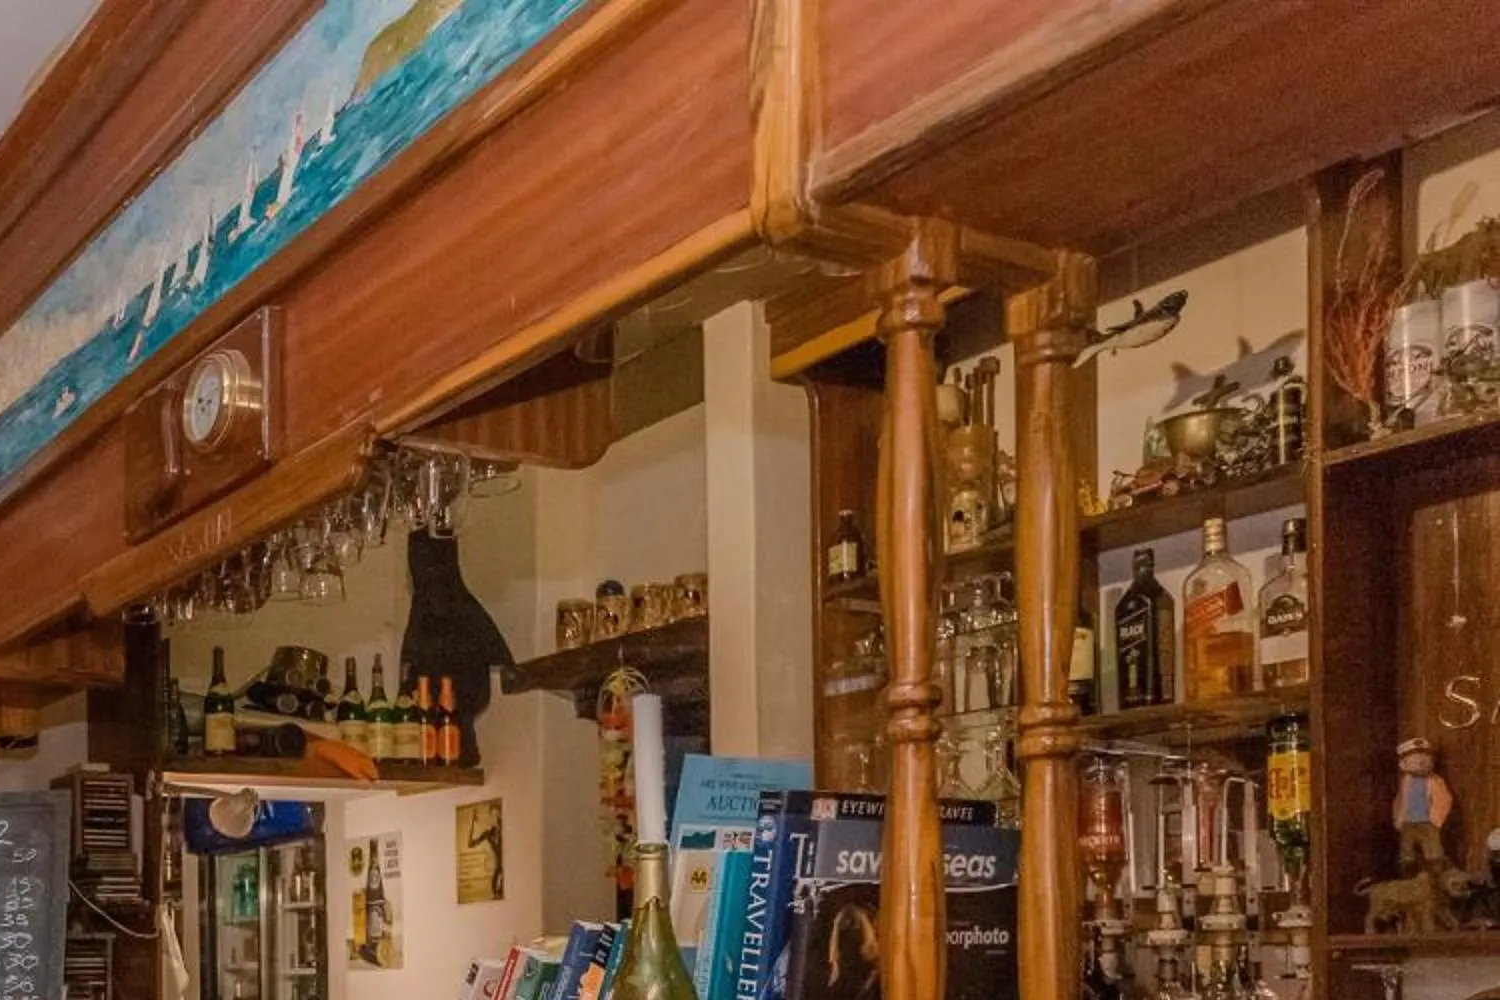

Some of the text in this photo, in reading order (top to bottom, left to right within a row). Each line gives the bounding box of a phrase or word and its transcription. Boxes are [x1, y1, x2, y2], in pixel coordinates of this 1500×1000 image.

[939, 806, 974, 821] RAVEL
[834, 850, 884, 875] sav
[945, 924, 1010, 950] orphoto
